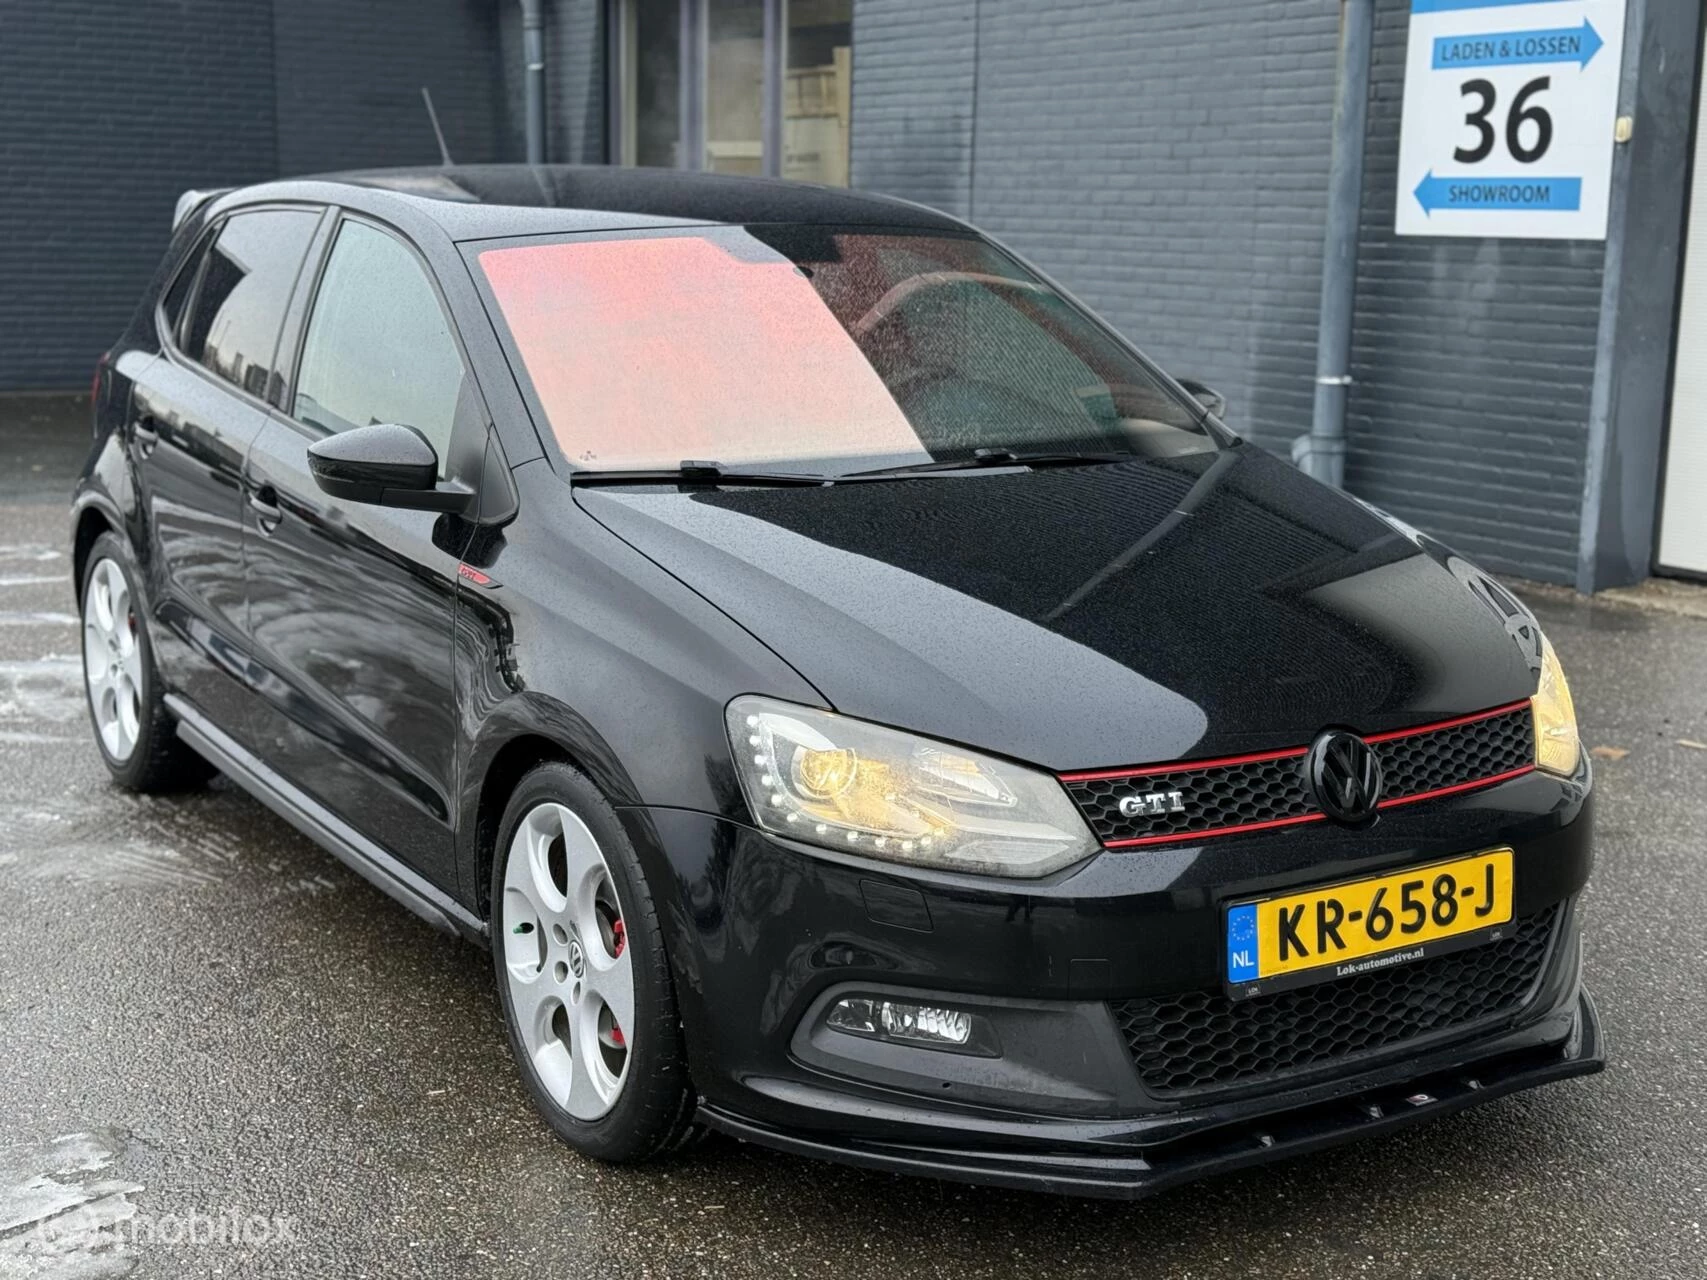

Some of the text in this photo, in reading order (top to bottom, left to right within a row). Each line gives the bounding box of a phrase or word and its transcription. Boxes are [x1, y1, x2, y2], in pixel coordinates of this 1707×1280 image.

[1441, 36, 1581, 61] LADEN & LOSSEN
[1453, 75, 1553, 164] 36
[1448, 184, 1551, 204] SHOWROOM
[1119, 791, 1186, 818] GTI
[1278, 863, 1495, 961] KR-658-J
[1232, 950, 1255, 968] NL
